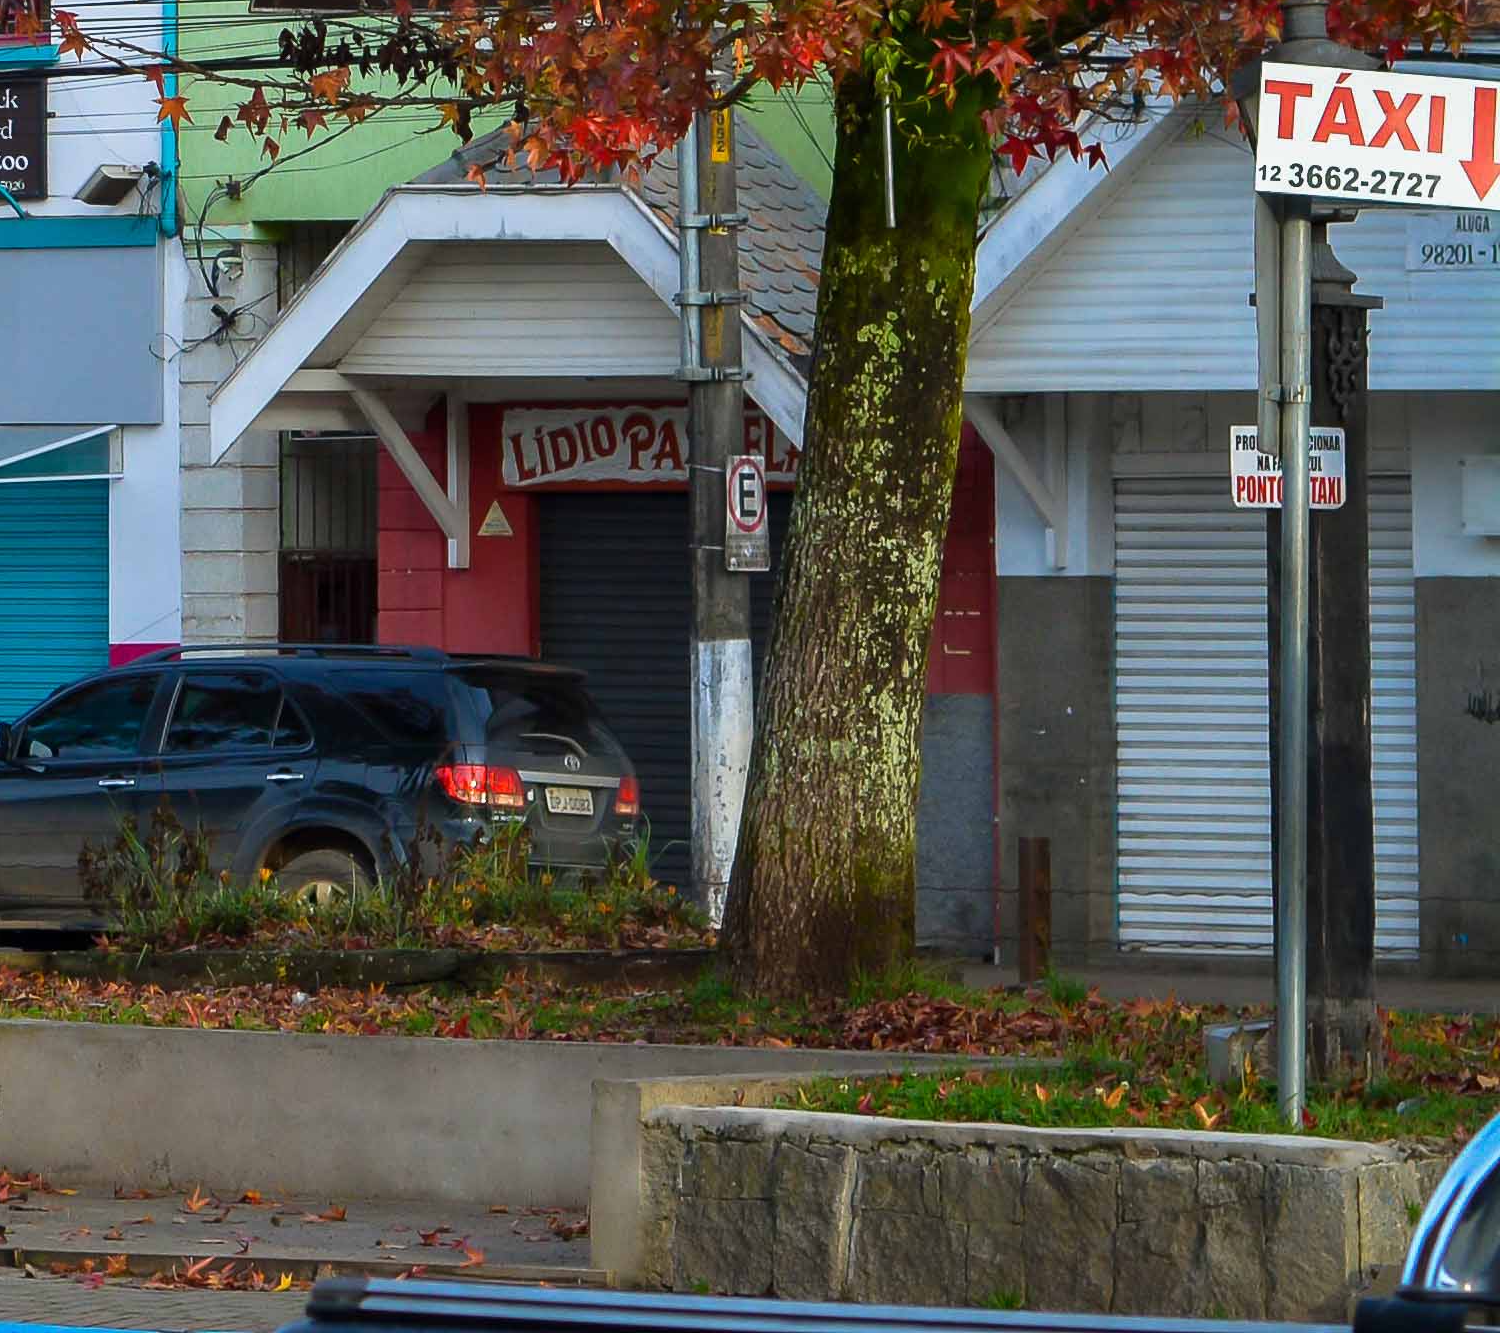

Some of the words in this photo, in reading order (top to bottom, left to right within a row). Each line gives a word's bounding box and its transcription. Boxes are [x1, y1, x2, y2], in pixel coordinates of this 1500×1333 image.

[1264, 71, 1446, 155] TÁXI
[1258, 164, 1282, 183] 12
[1287, 162, 1442, 199] 3662-2727
[1455, 214, 1491, 234] ALUGA
[507, 415, 619, 483] LÍDIO
[738, 472, 758, 518] E
[1310, 476, 1342, 505] TAXI
